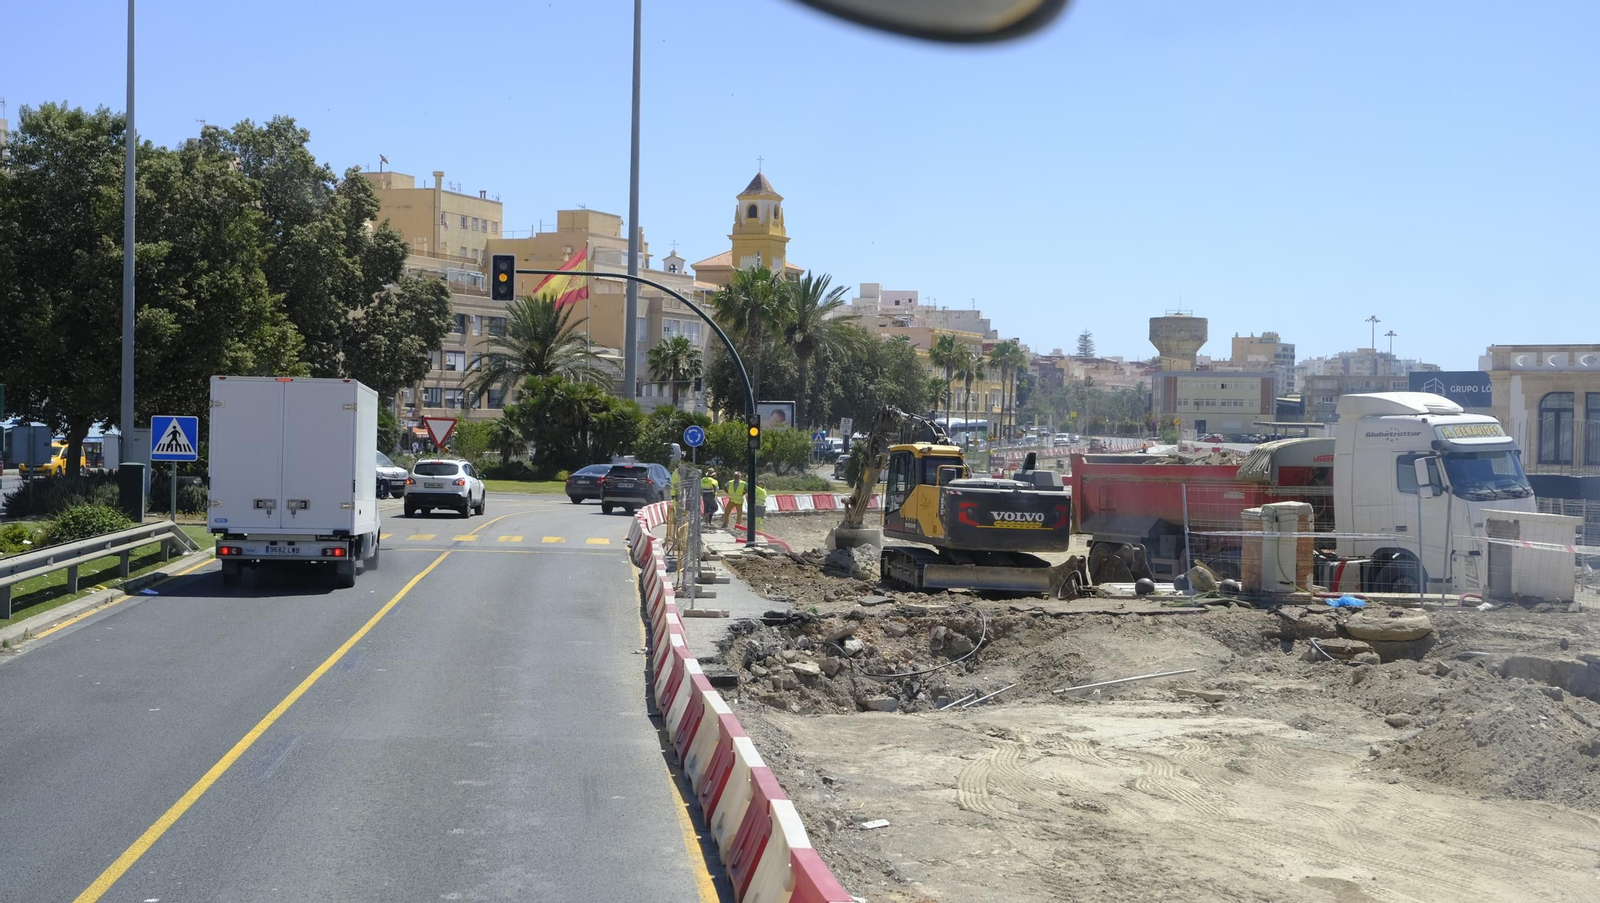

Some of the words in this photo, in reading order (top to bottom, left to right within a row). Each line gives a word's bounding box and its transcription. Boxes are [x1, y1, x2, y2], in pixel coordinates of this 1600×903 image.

[1450, 385, 1479, 393] GRUPO
[1453, 425, 1502, 438] BENAVIDES
[990, 511, 1045, 522] VOLVO
